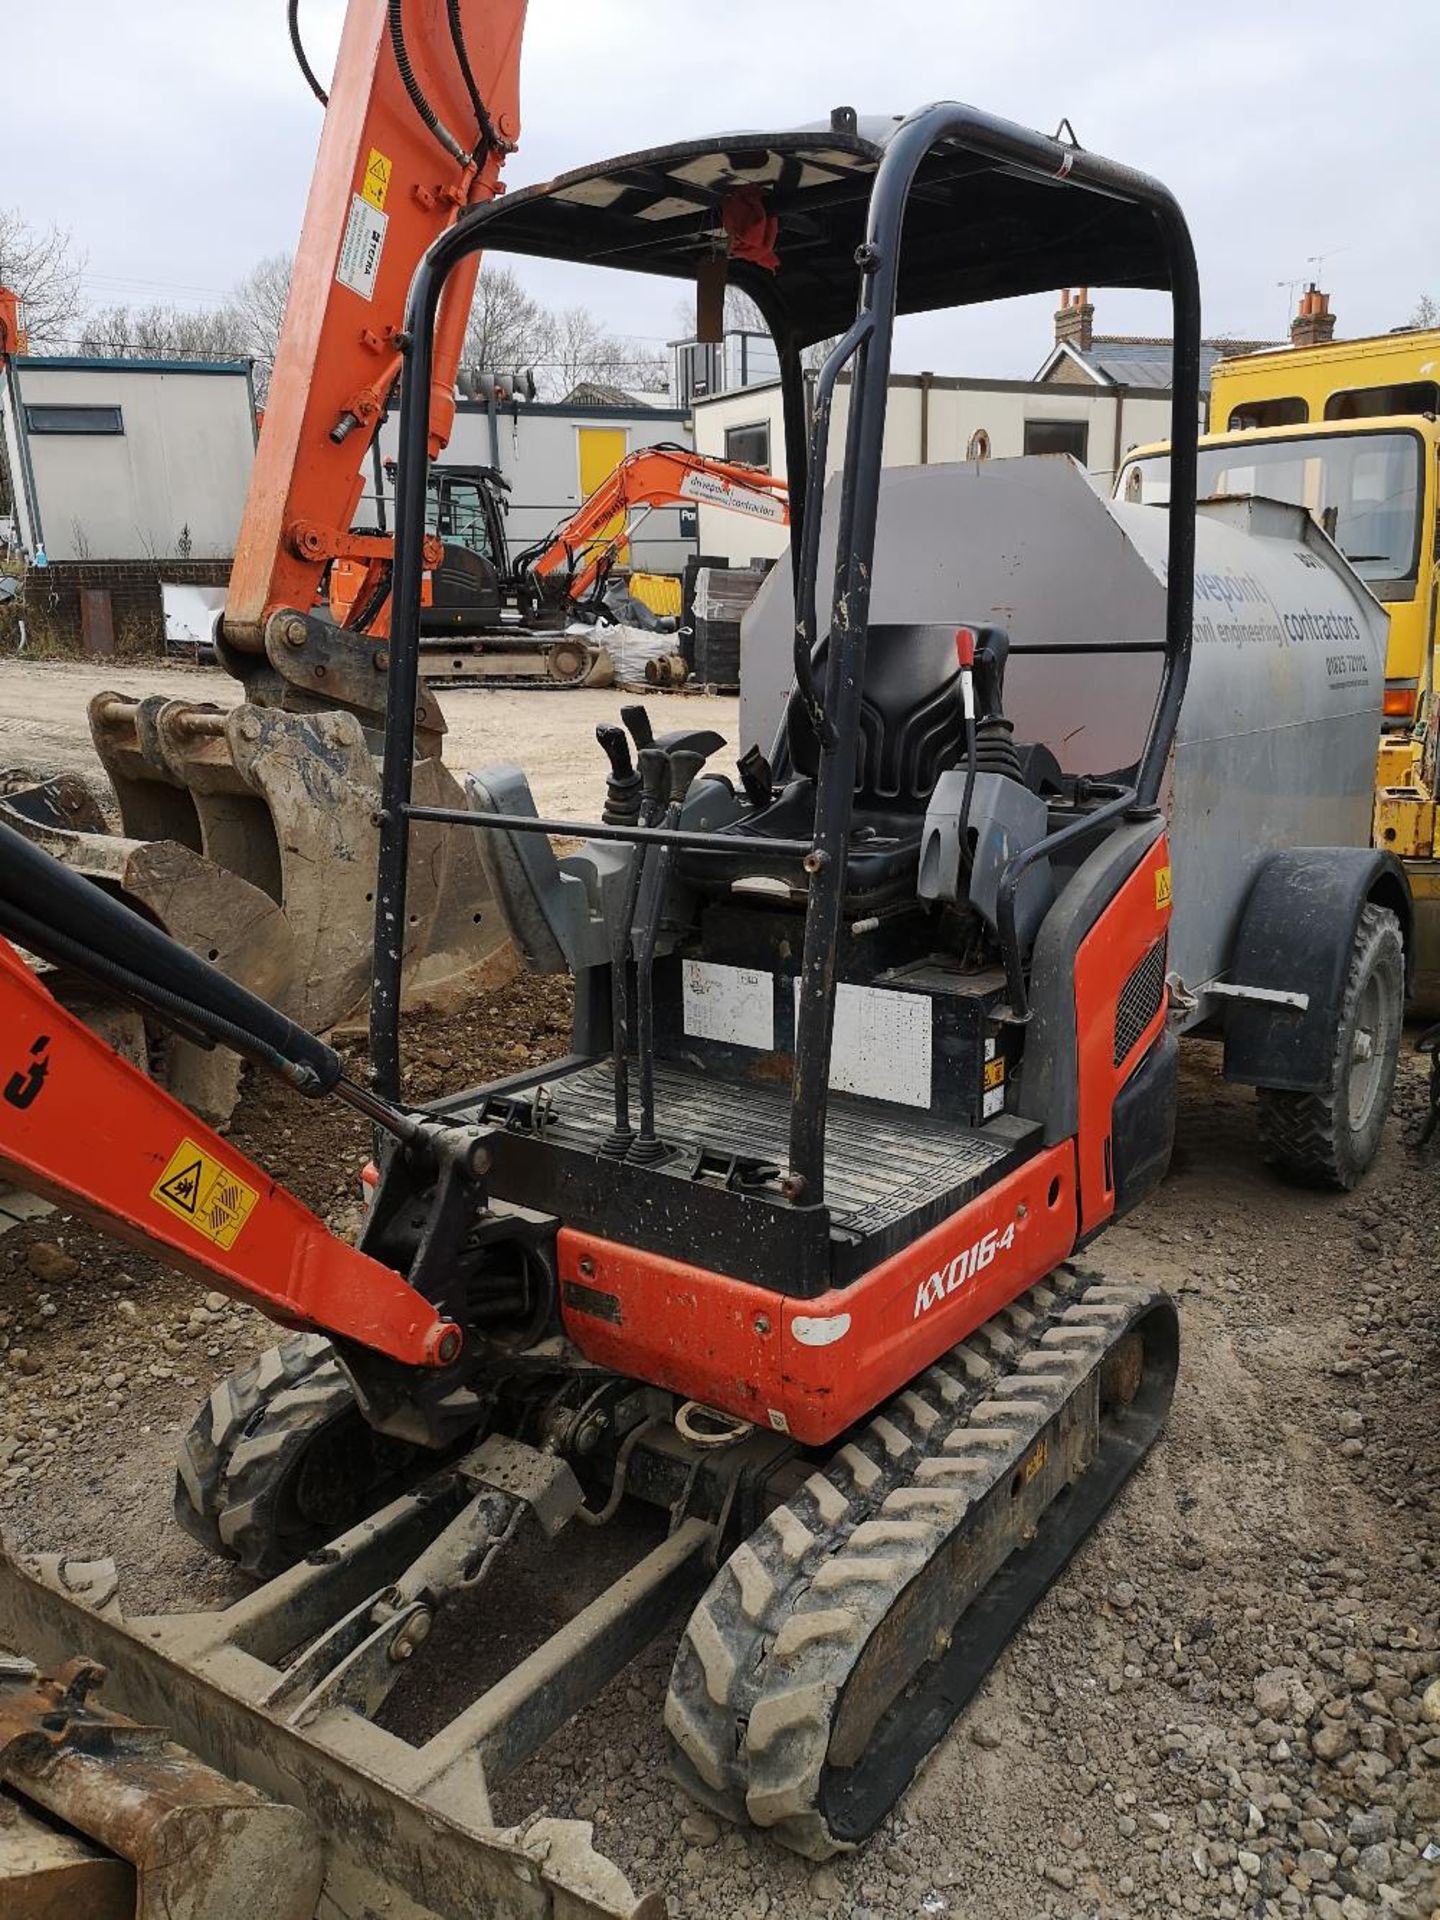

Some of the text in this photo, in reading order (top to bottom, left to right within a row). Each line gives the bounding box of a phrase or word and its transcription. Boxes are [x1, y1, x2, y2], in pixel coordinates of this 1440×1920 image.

[1217, 617, 1283, 647] engineering
[1283, 609, 1360, 642] contractors
[914, 1222, 1015, 1319] KX016-4
